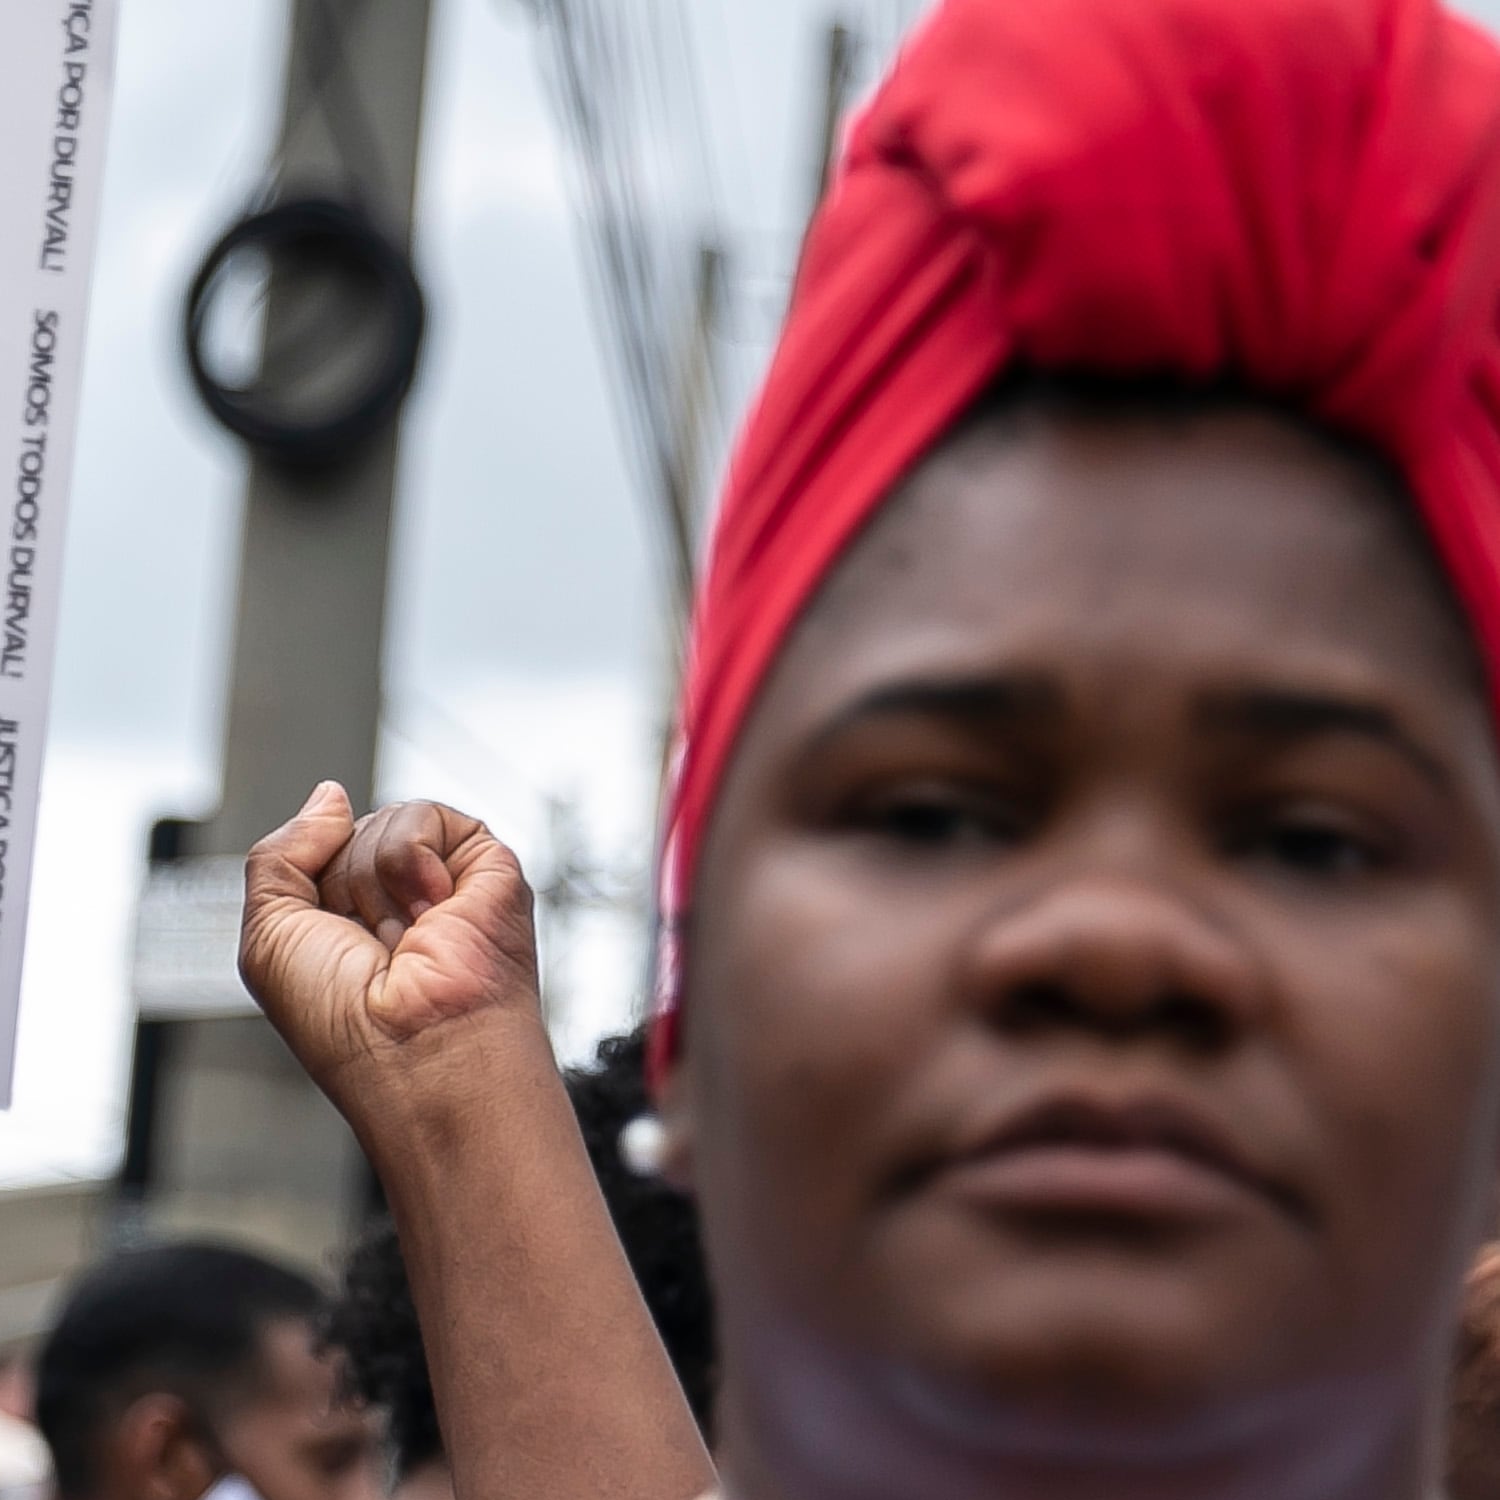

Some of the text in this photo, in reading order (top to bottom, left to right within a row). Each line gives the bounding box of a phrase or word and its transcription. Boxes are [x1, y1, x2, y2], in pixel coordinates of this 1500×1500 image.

[40, 0, 92, 272] IÇA POR DURVAL!
[23, 309, 59, 427] SOMOS
[13, 431, 47, 542] TODOS
